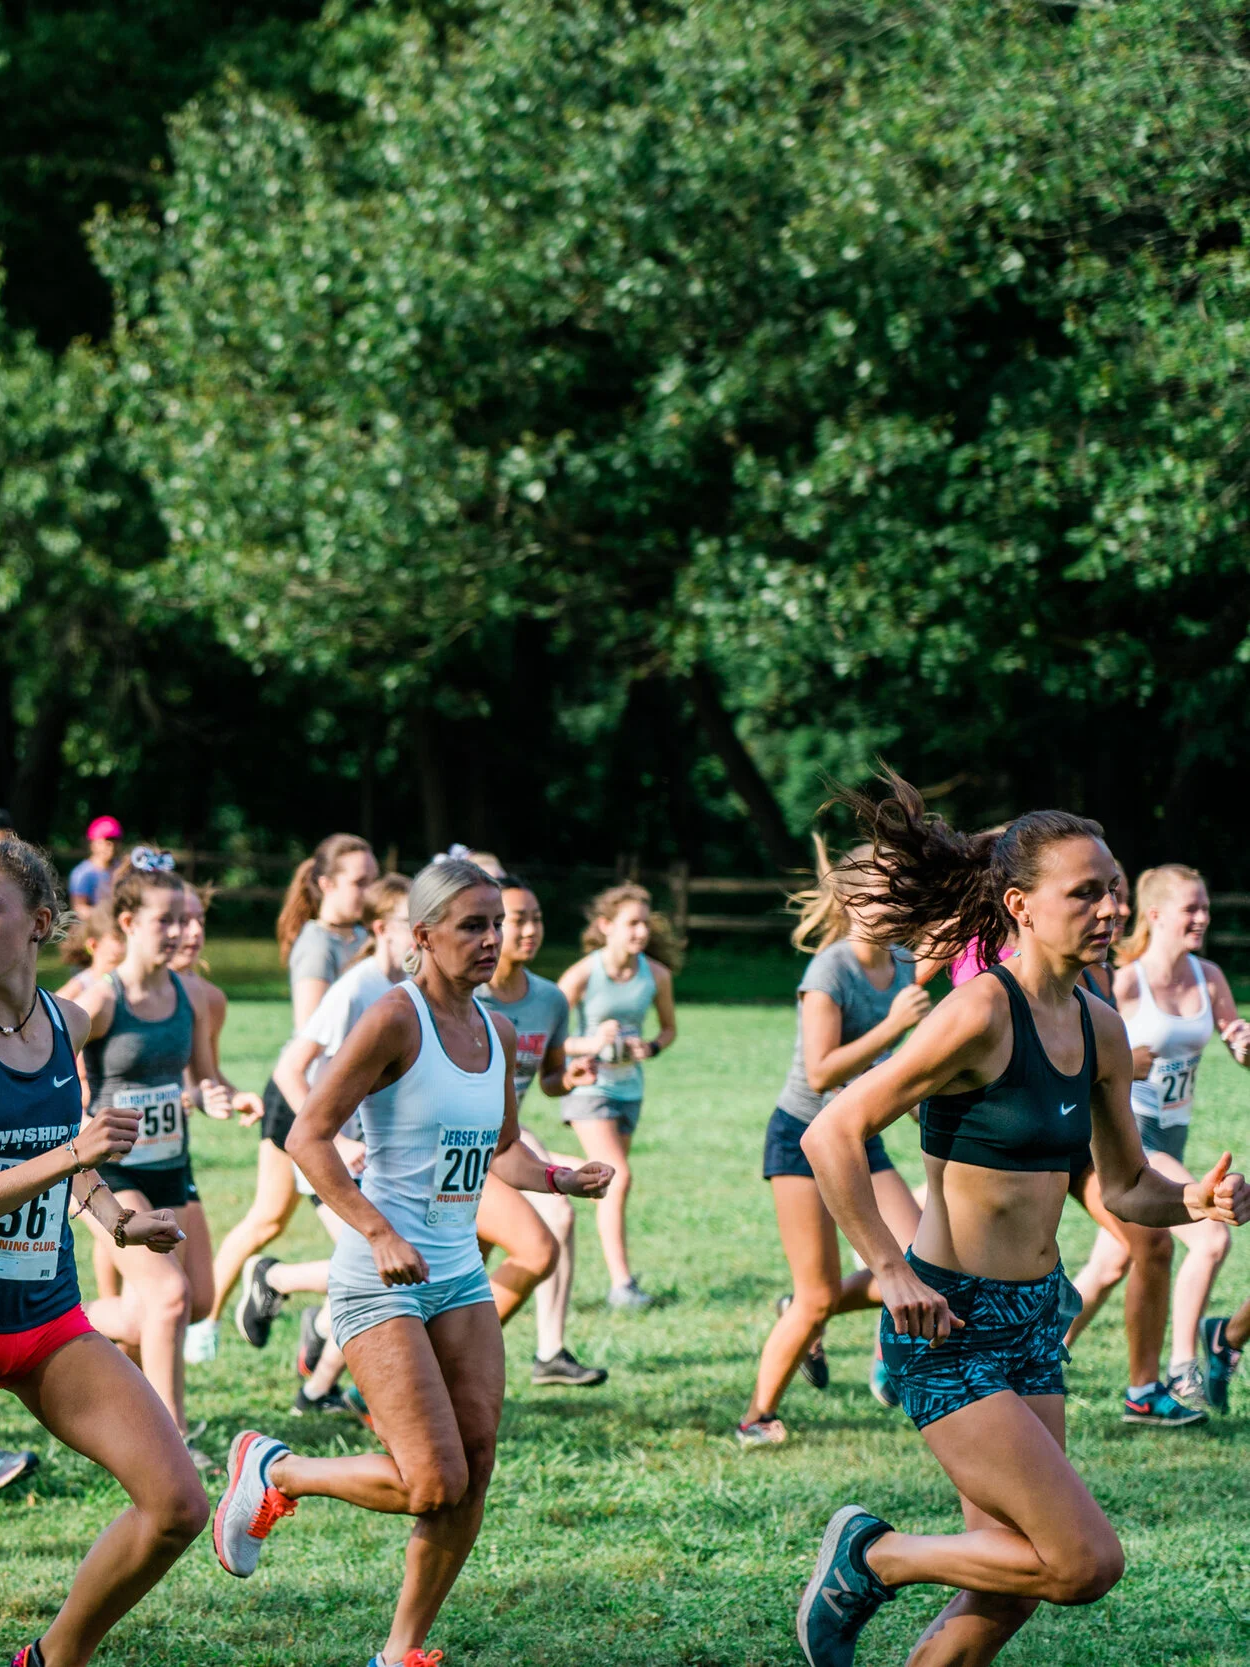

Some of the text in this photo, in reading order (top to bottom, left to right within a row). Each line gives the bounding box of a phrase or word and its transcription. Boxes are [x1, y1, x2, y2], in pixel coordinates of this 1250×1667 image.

[136, 1103, 177, 1136] 59
[441, 1130, 479, 1146] JERSEY
[33, 1242, 56, 1252] CLUB
